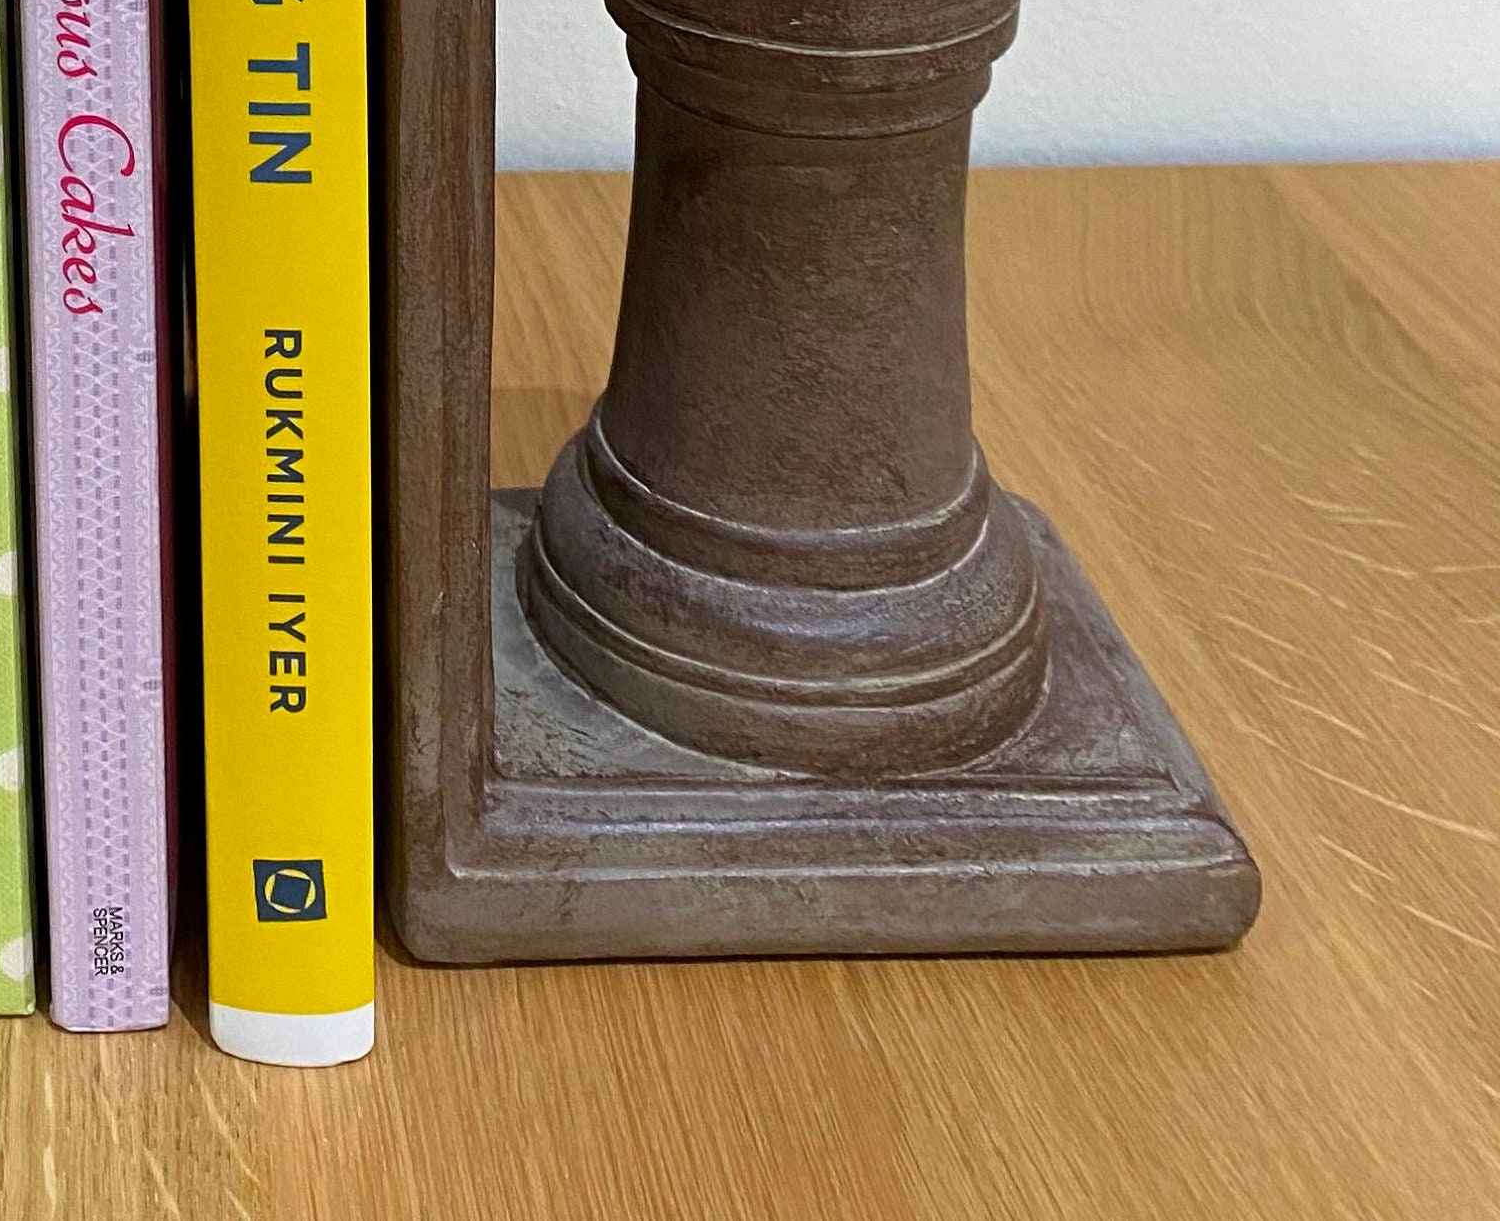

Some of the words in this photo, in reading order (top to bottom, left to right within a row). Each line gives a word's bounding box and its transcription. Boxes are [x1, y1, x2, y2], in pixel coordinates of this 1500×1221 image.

[247, 43, 313, 185] TIN
[57, 114, 137, 316] Cakes
[263, 329, 306, 565] RUKMINI
[268, 594, 307, 715] IYER
[92, 907, 109, 977] SPENCER
[109, 906, 124, 962] MARKS
[110, 964, 124, 976] &
